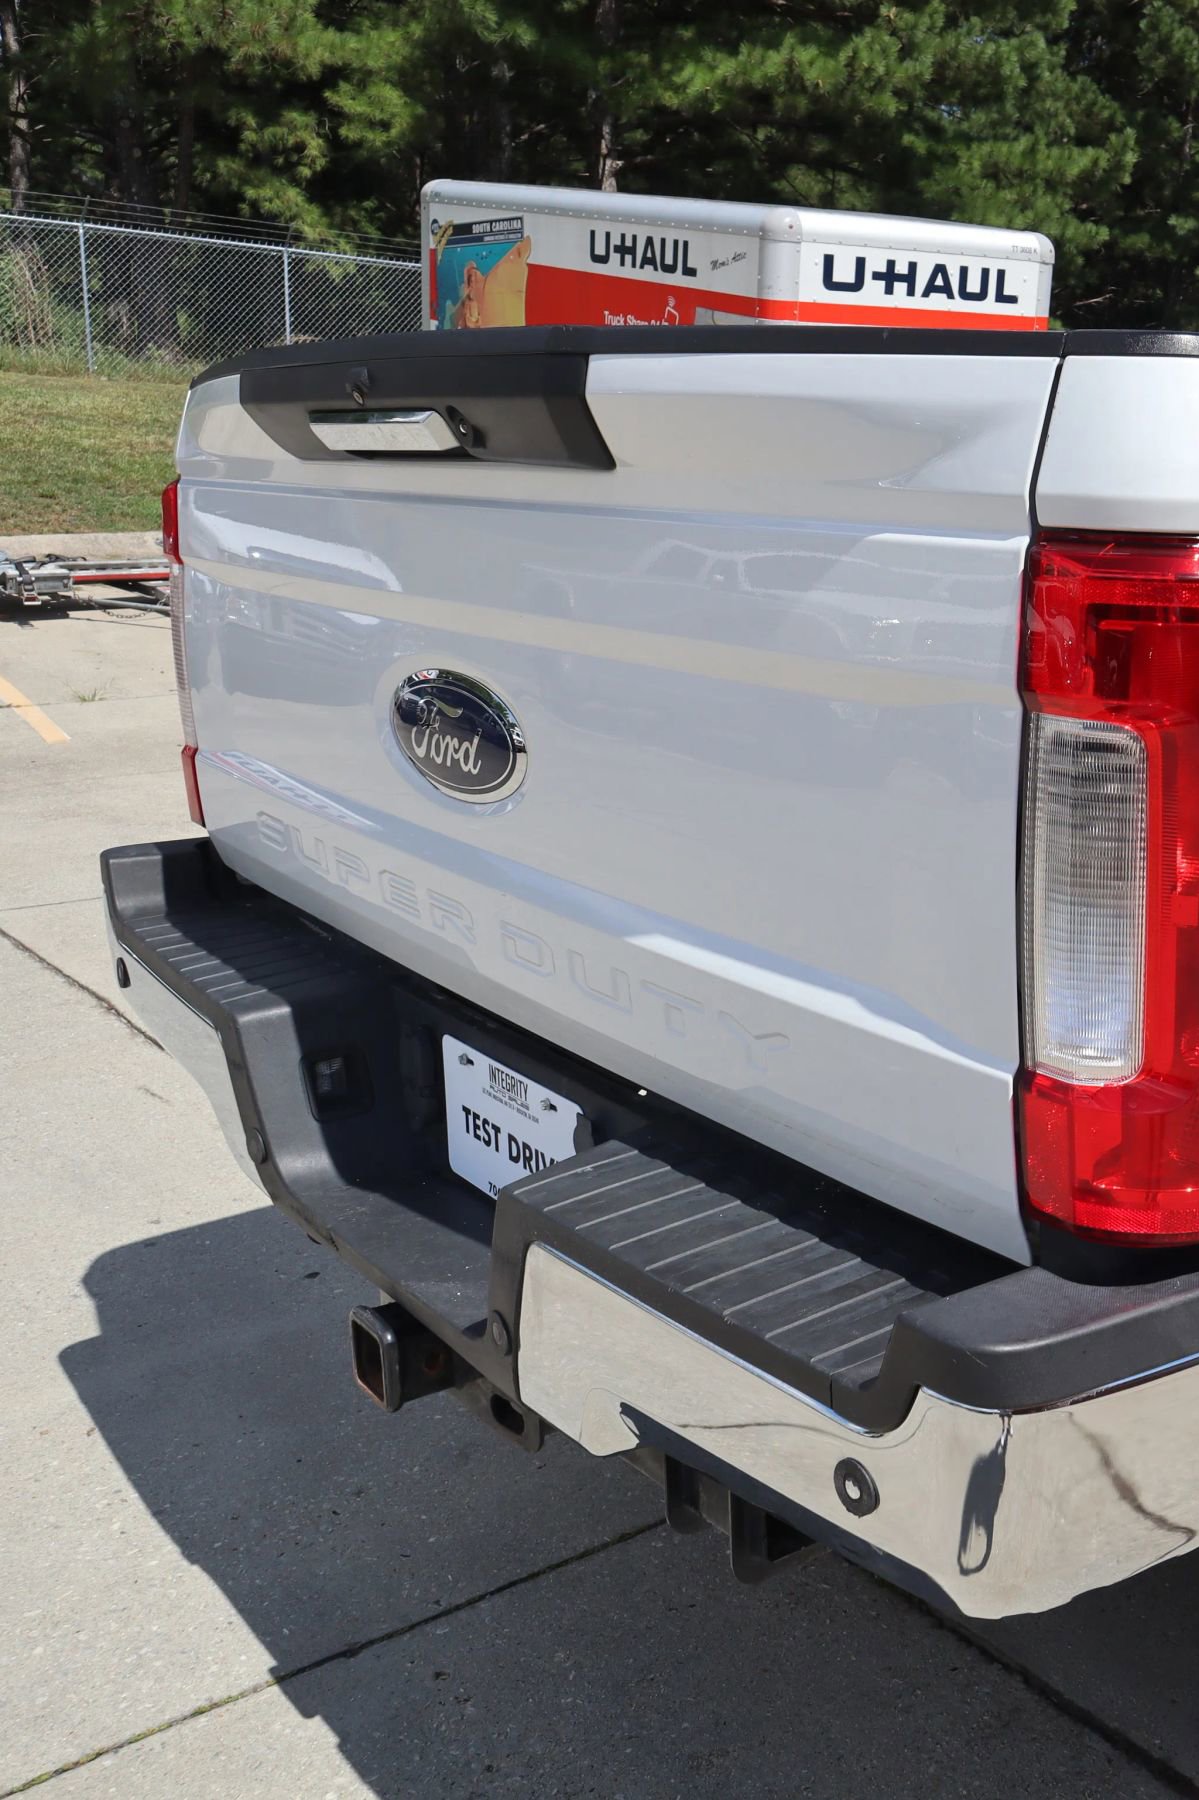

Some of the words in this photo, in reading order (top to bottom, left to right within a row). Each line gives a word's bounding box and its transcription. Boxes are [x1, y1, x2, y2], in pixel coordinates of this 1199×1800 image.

[472, 222, 490, 234] SOUTH
[491, 218, 522, 232] CAROLINA
[604, 310, 625, 326] Truck
[411, 695, 483, 775] Ford
[255, 810, 478, 945] SUPER
[499, 919, 791, 1075] DUTY
[488, 1063, 529, 1102] INTEGRITY
[462, 1104, 502, 1153] TEST
[507, 1133, 559, 1175] DRIV
[488, 1180, 500, 1197] 70
